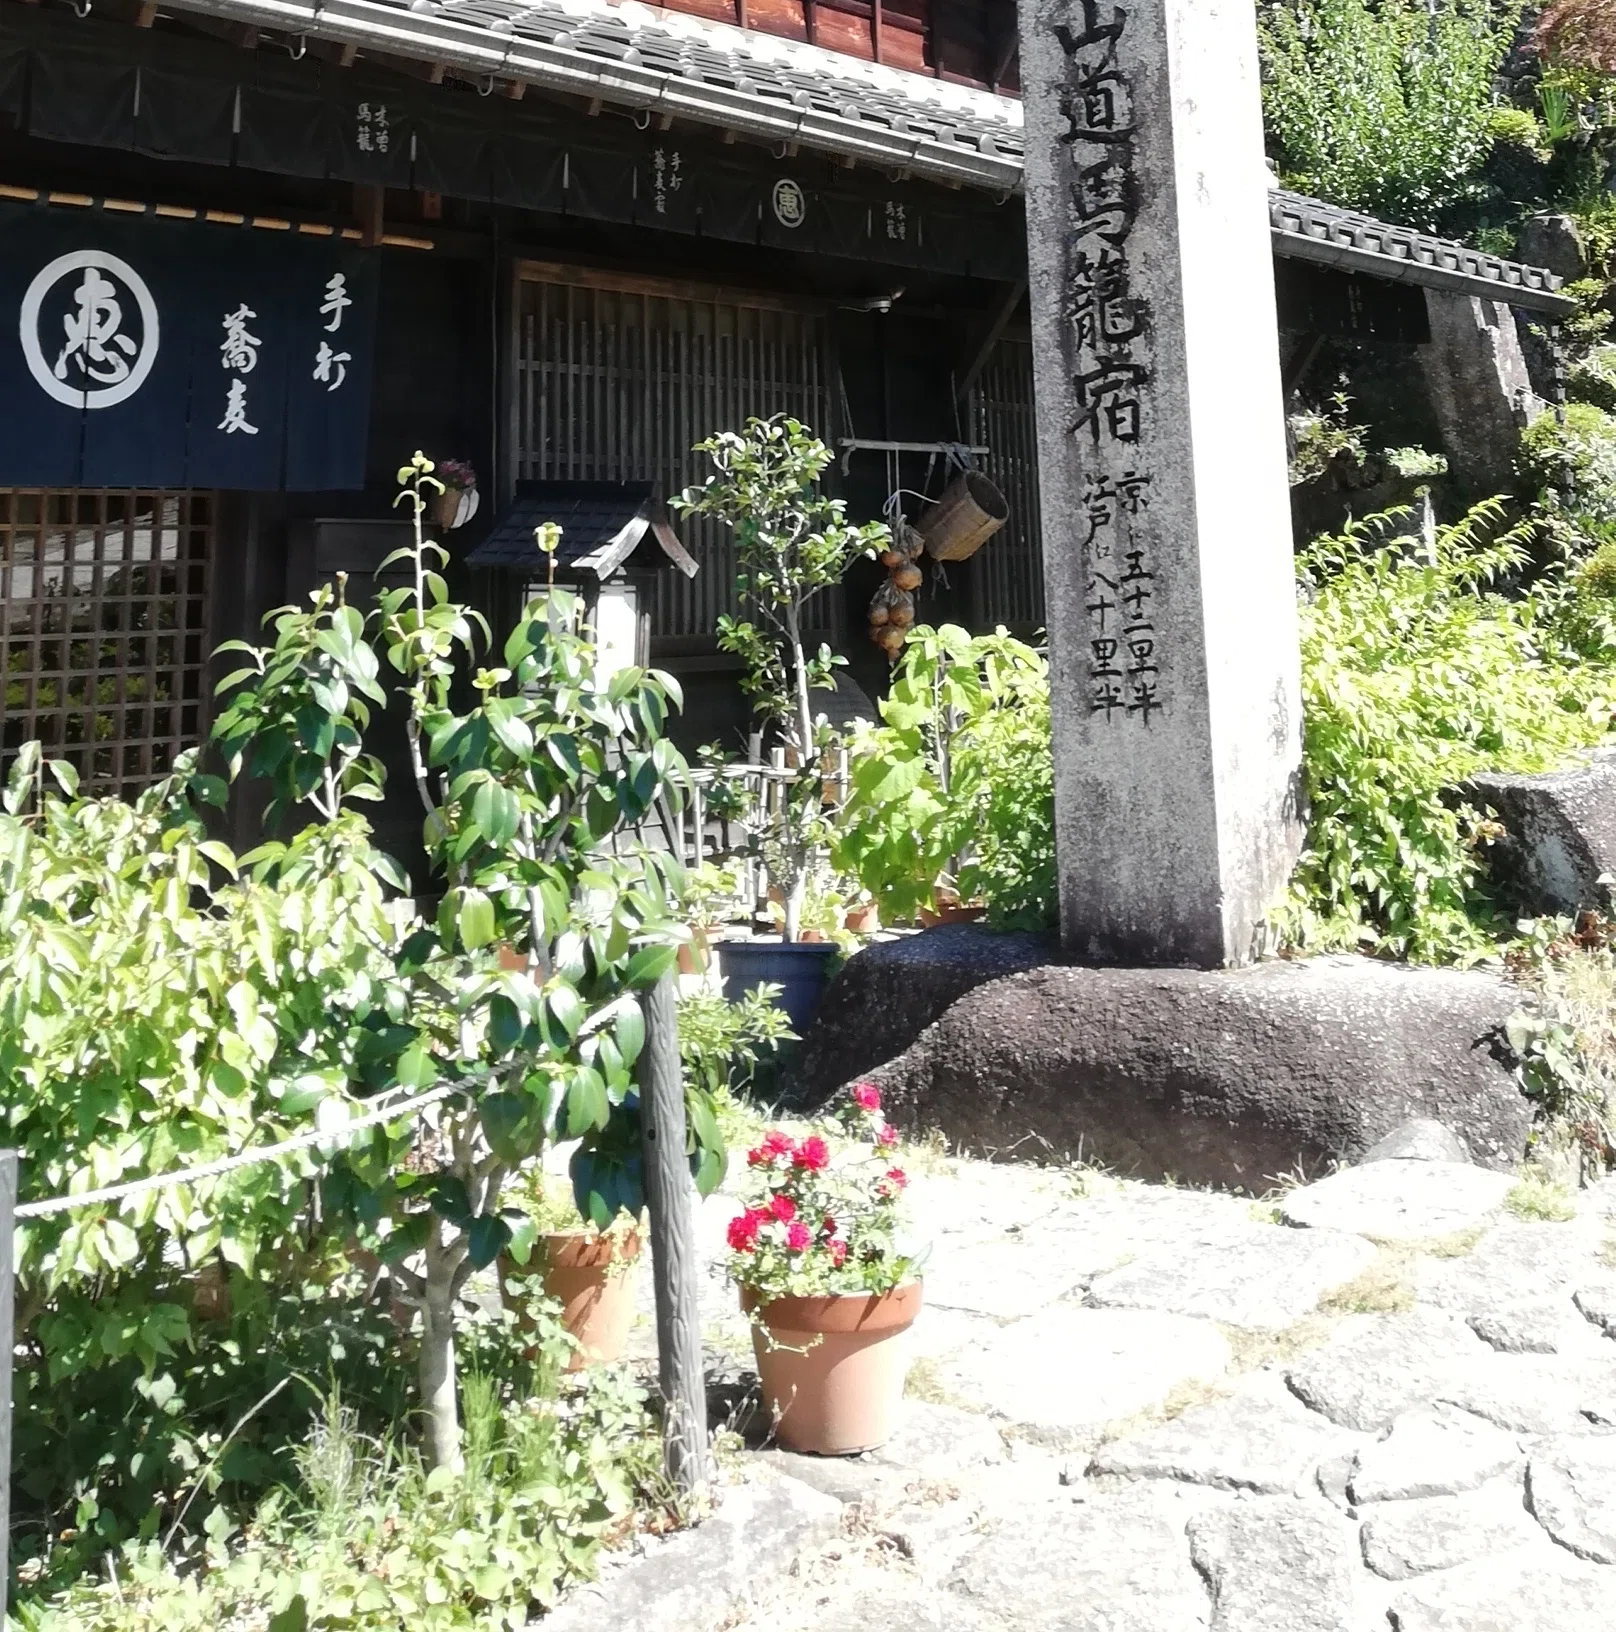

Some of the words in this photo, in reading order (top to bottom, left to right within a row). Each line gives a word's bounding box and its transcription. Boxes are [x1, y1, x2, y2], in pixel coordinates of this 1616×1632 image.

[356, 102, 374, 152] 馬籠
[669, 151, 683, 192] 手打
[53, 267, 138, 384] 恵
[216, 303, 263, 436] 蕎麦
[312, 272, 353, 392] 手打
